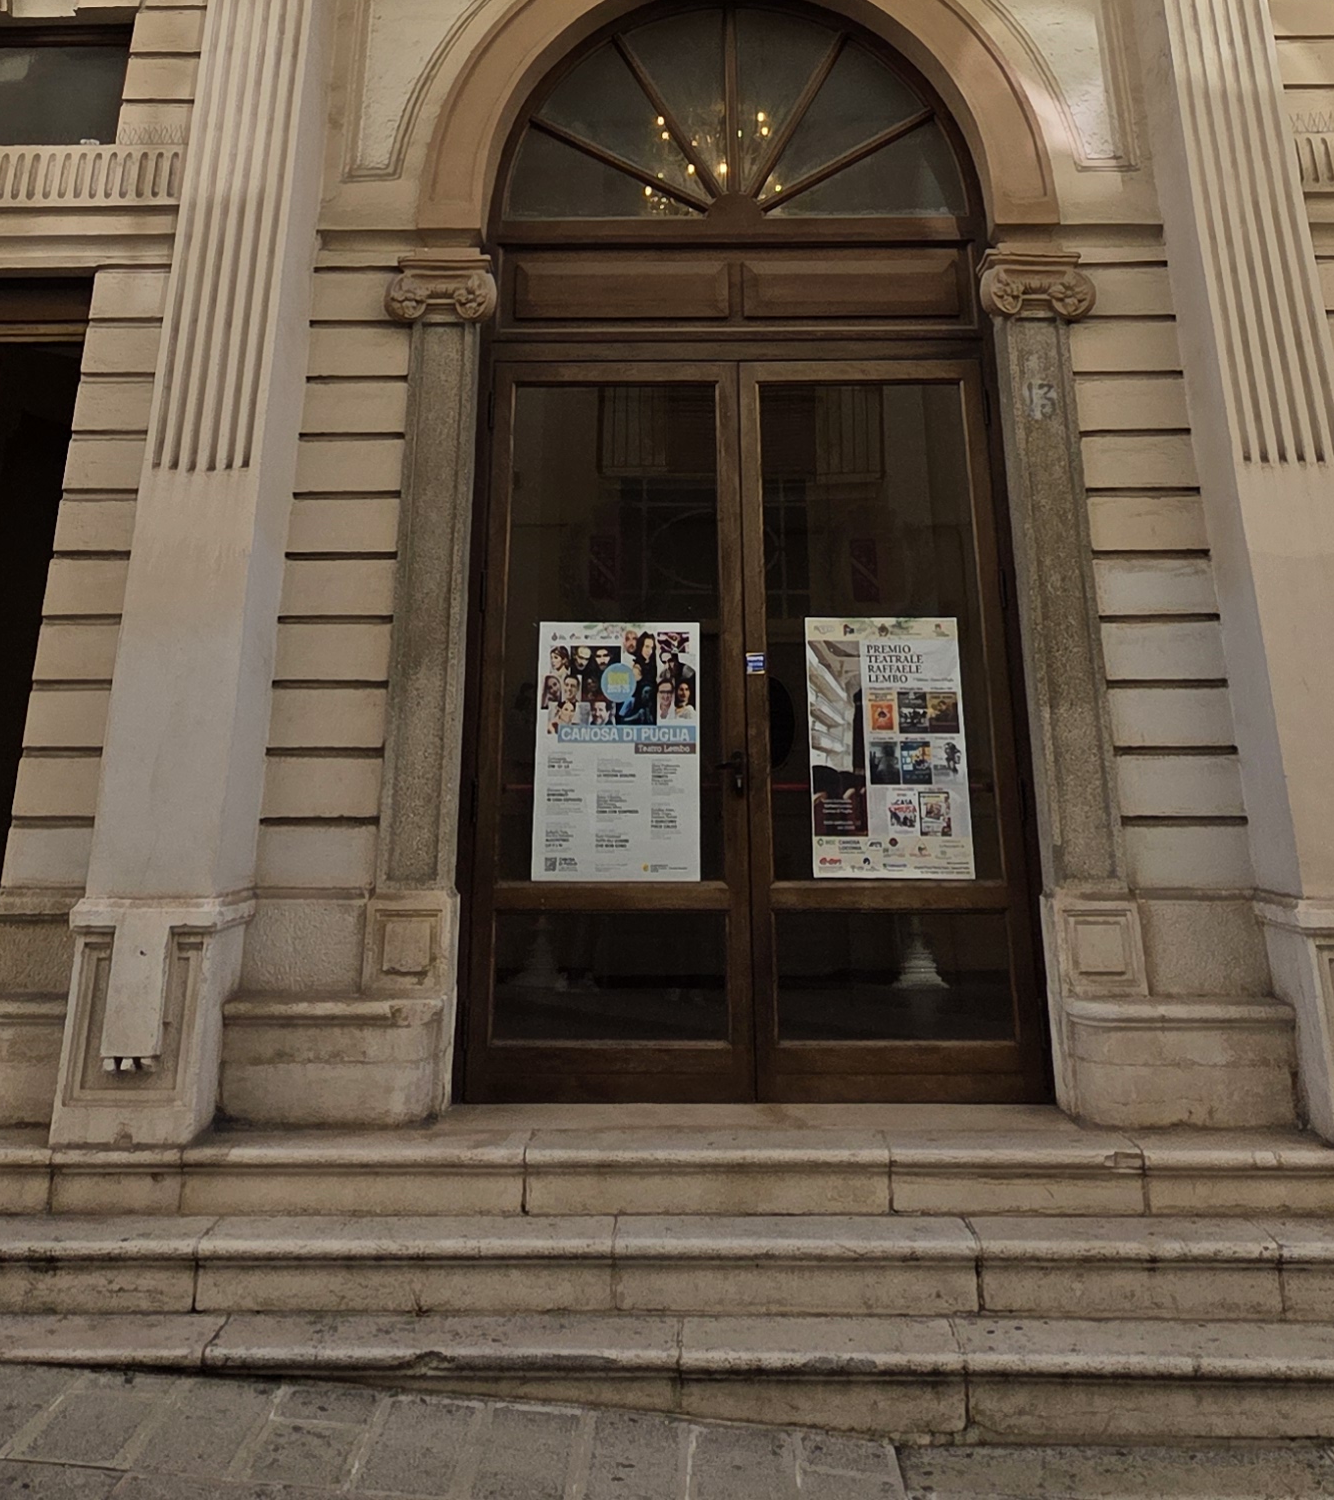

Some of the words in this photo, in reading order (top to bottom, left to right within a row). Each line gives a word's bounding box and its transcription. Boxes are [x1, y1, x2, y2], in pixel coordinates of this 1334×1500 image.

[1027, 381, 1057, 420] 13
[867, 644, 911, 654] PREMIO
[867, 654, 924, 664] TEATRALE
[868, 664, 923, 674] RAFFAELE
[868, 674, 908, 684] LEMBO
[561, 728, 619, 741] CANOSA
[623, 728, 637, 741] DI
[641, 728, 690, 741] PUGLIA
[638, 744, 662, 753] Teatro
[664, 744, 690, 753] Lembo
